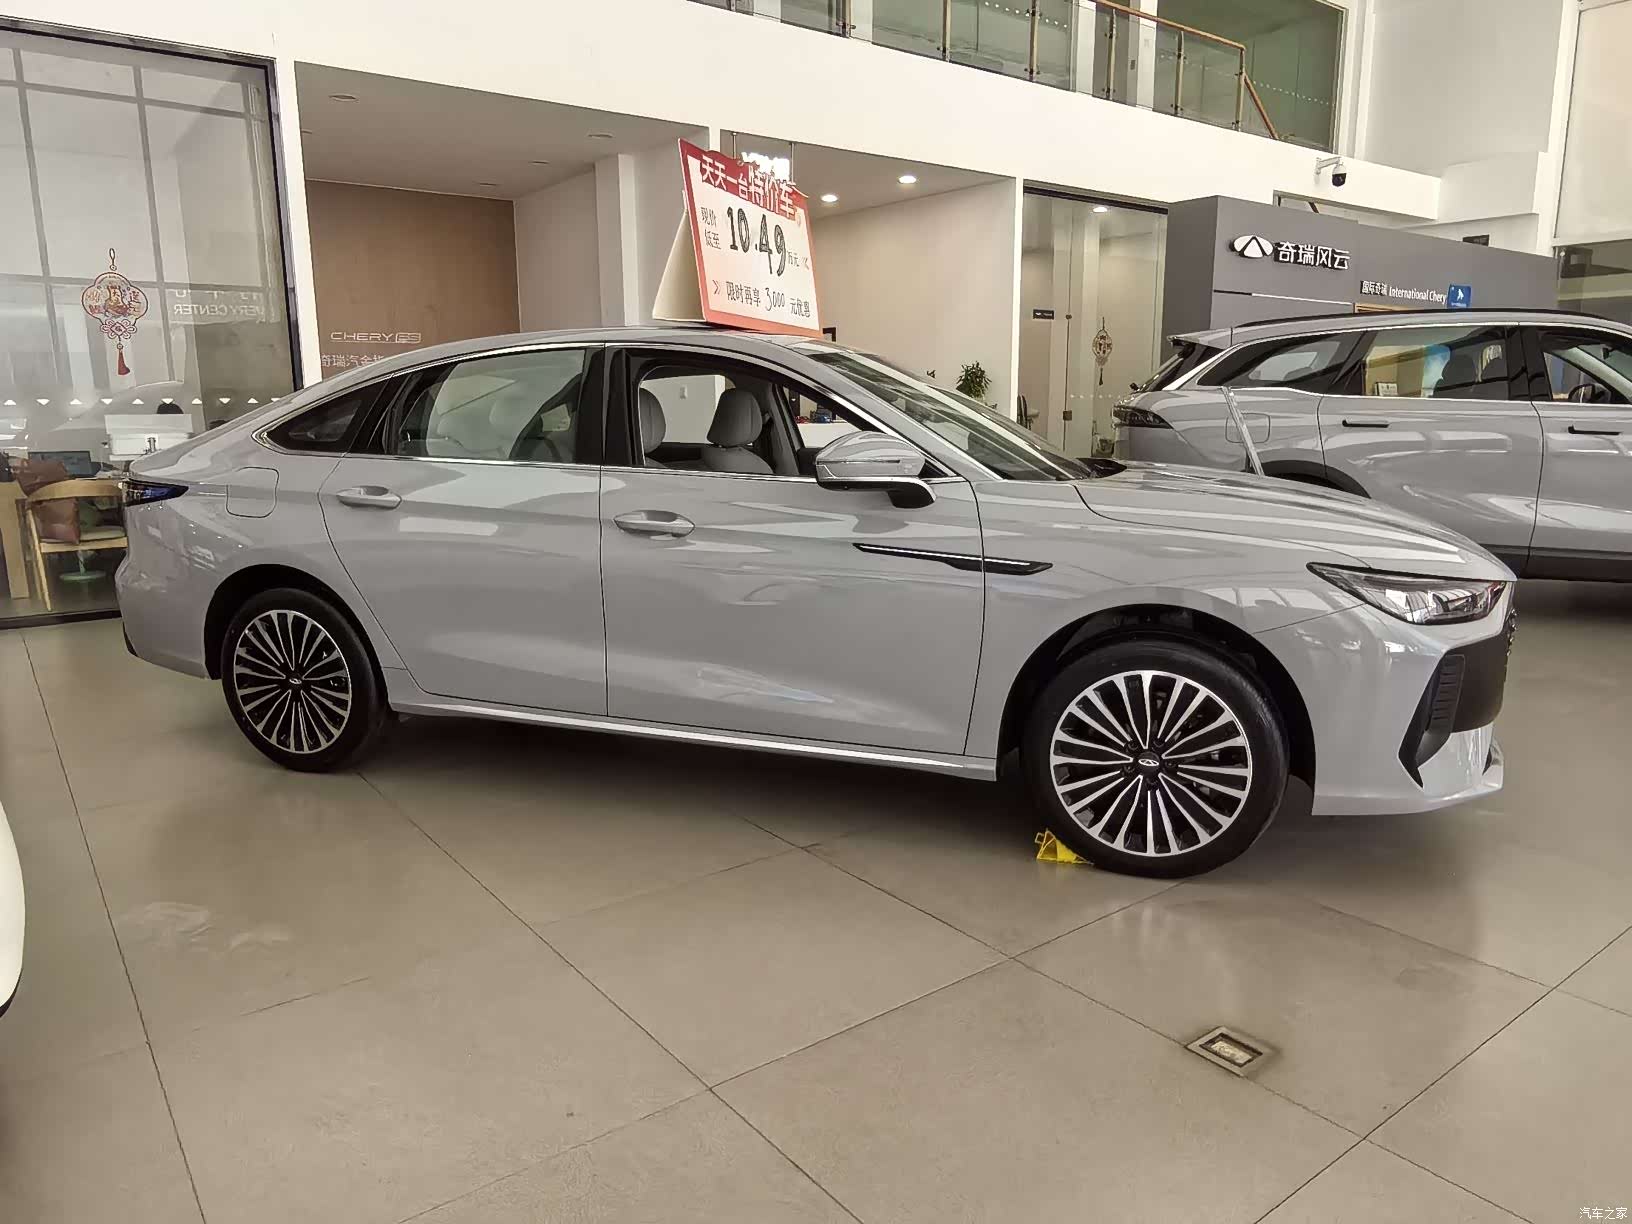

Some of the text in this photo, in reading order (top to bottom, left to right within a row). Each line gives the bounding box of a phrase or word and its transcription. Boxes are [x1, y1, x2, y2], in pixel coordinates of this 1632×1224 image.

[701, 155, 795, 217] 天天一台特价车
[726, 206, 787, 277] 10.49
[1277, 241, 1351, 270] 奇瑞风云
[765, 287, 785, 312] 3000
[1389, 286, 1429, 301] International
[1429, 291, 1447, 305] Chery
[330, 331, 394, 341] CHERY
